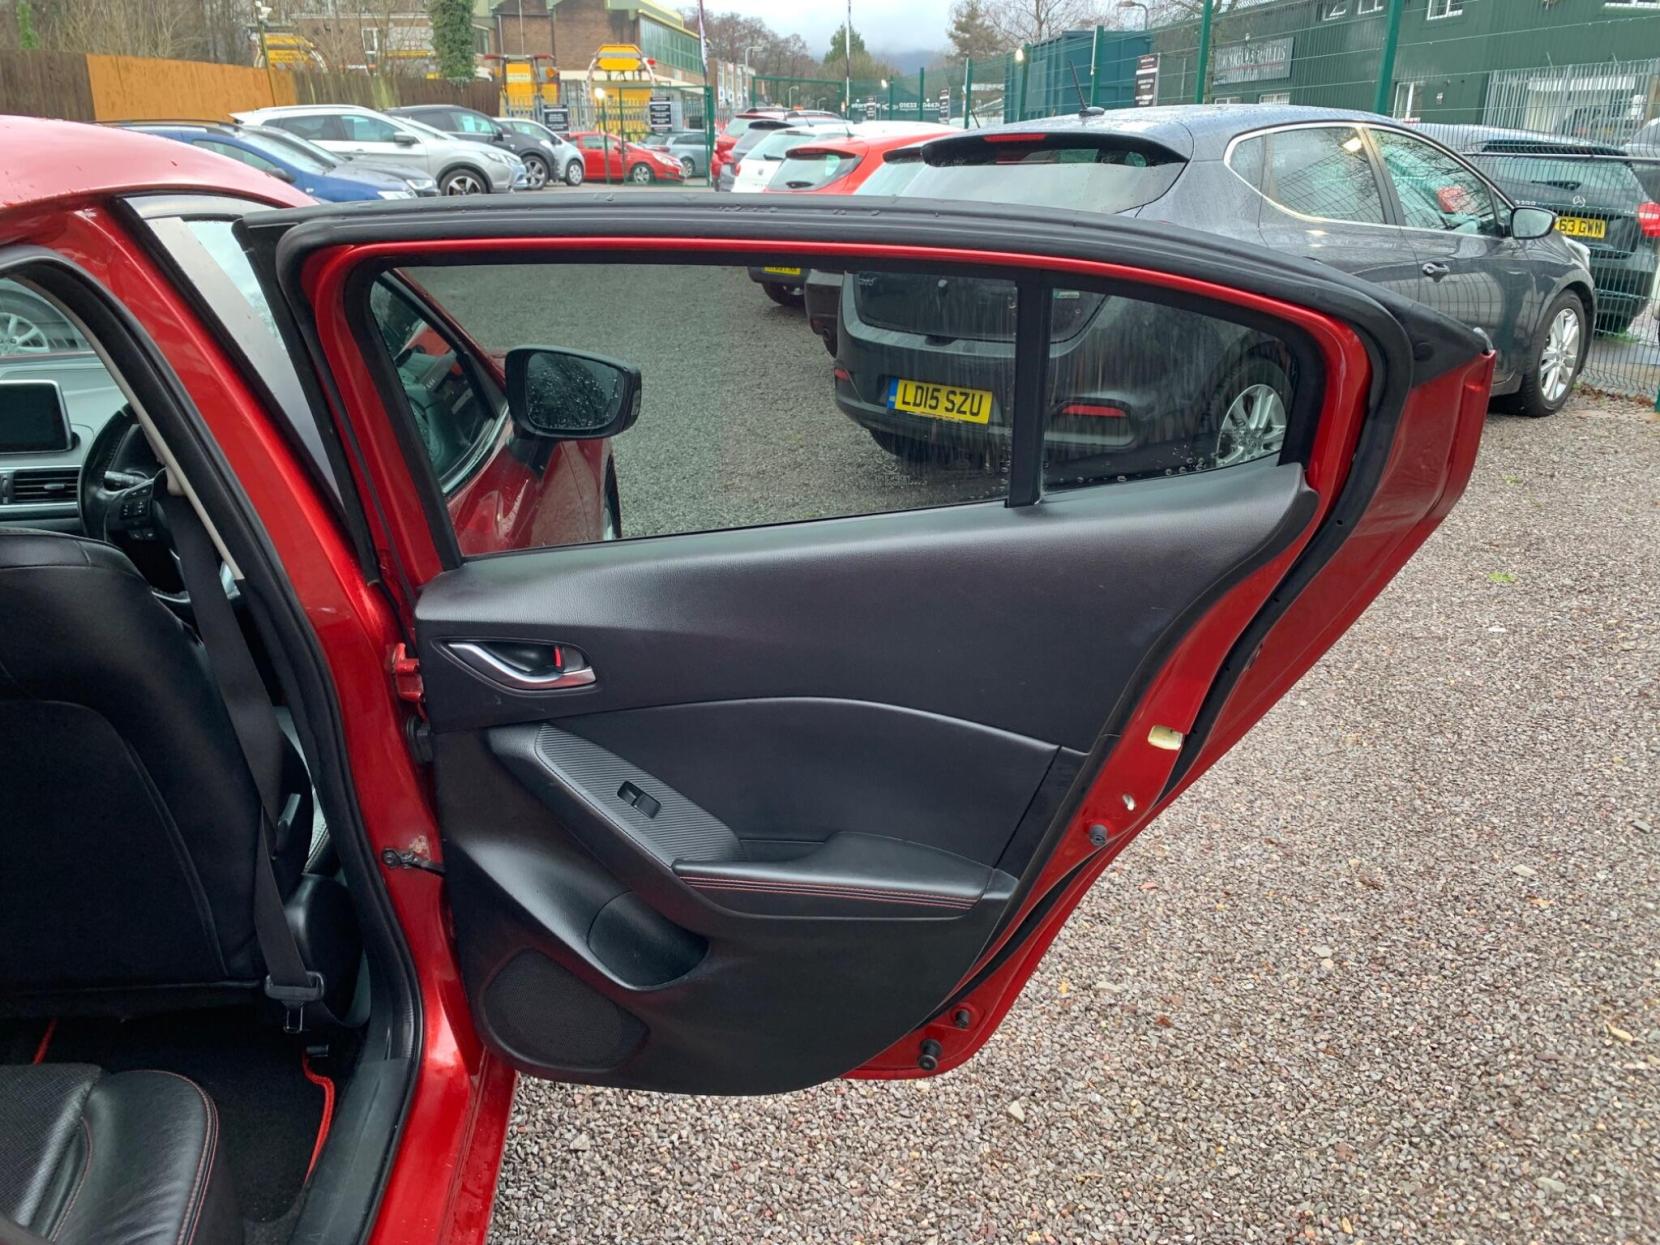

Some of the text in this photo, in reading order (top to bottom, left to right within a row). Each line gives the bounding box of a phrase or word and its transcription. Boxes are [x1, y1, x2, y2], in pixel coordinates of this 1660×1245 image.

[1578, 219, 1603, 235] GWN
[902, 383, 984, 417] LD15 SZU
